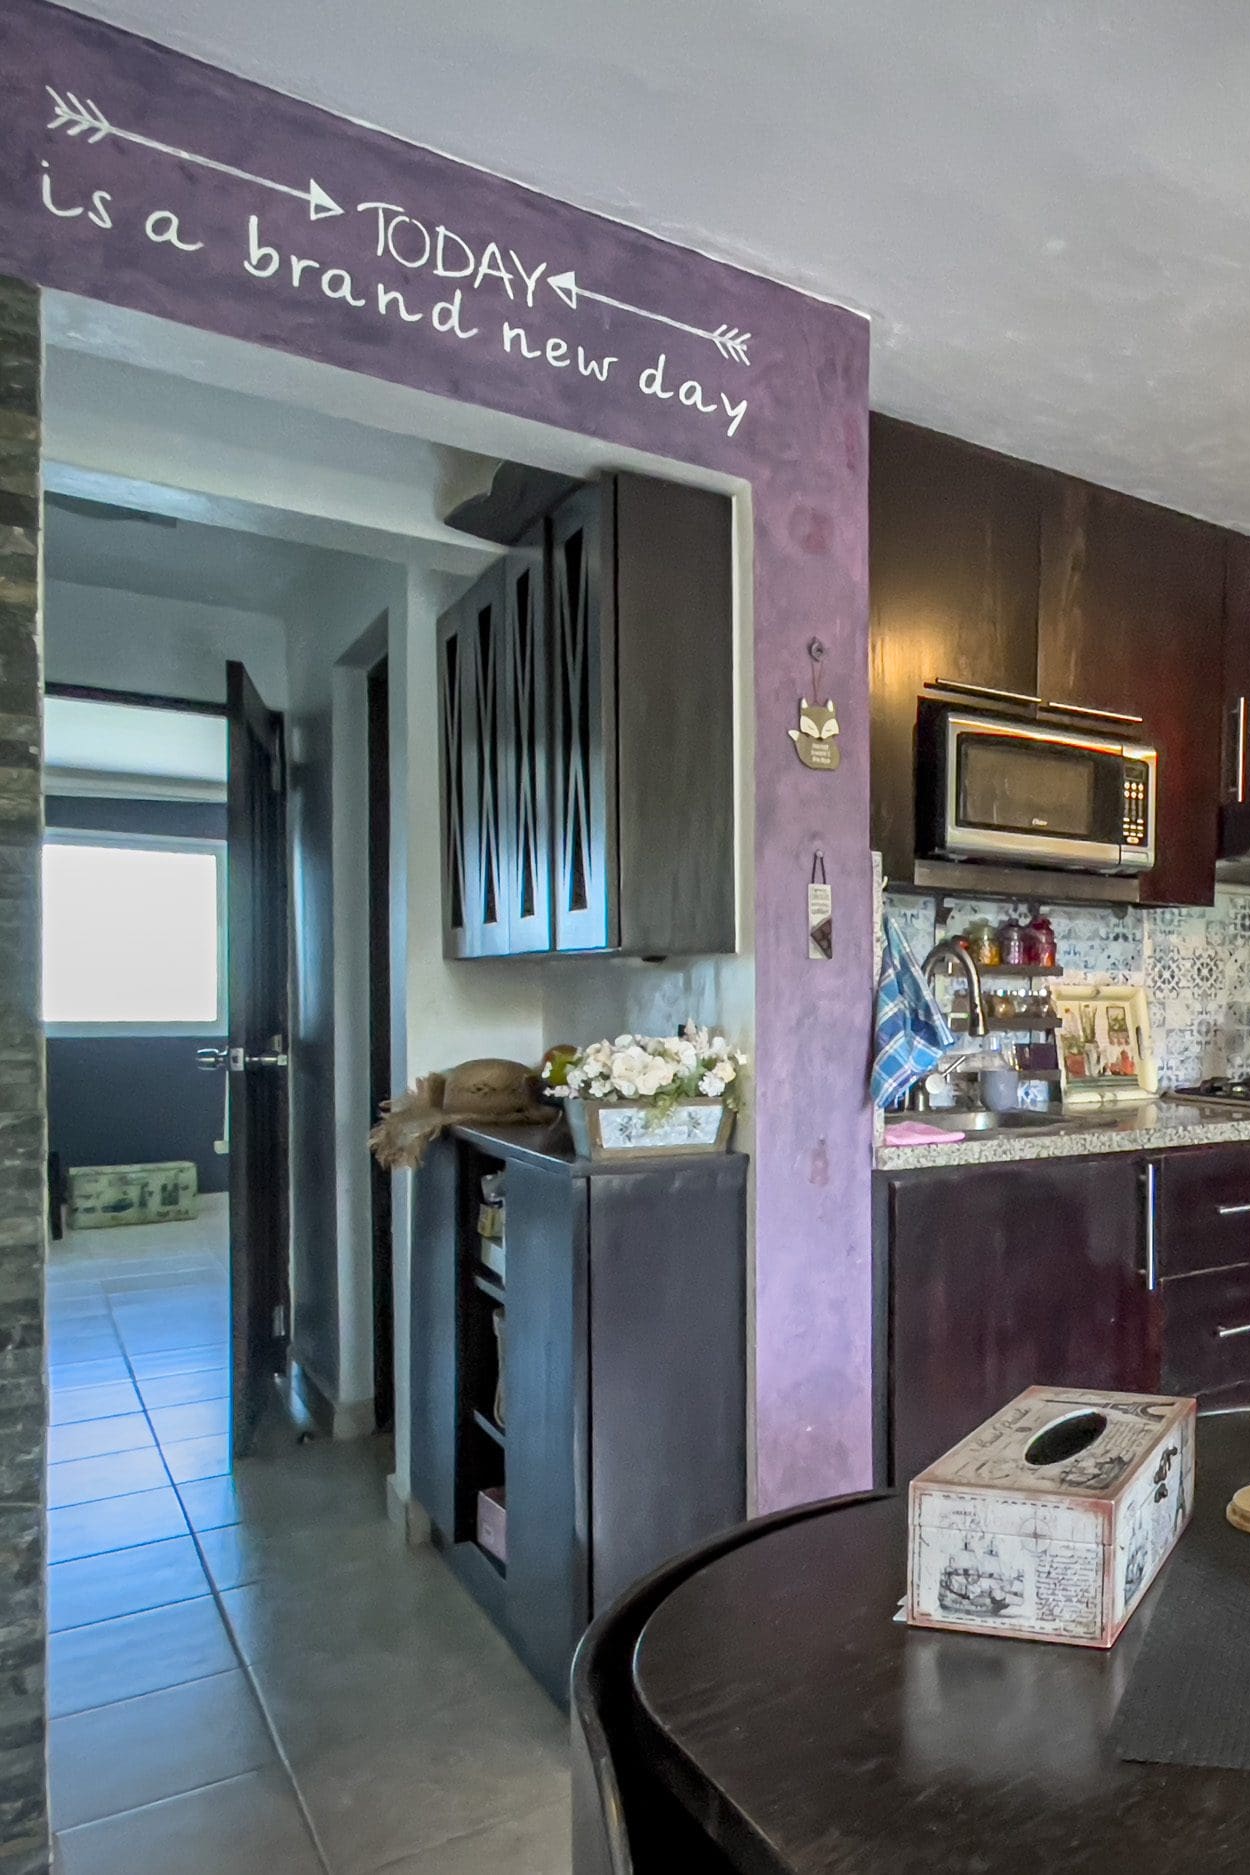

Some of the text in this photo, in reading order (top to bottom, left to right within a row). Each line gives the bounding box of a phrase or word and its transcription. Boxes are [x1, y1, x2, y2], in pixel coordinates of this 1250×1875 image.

[41, 160, 749, 438] is a brand new day
[357, 202, 547, 307] TODAY
